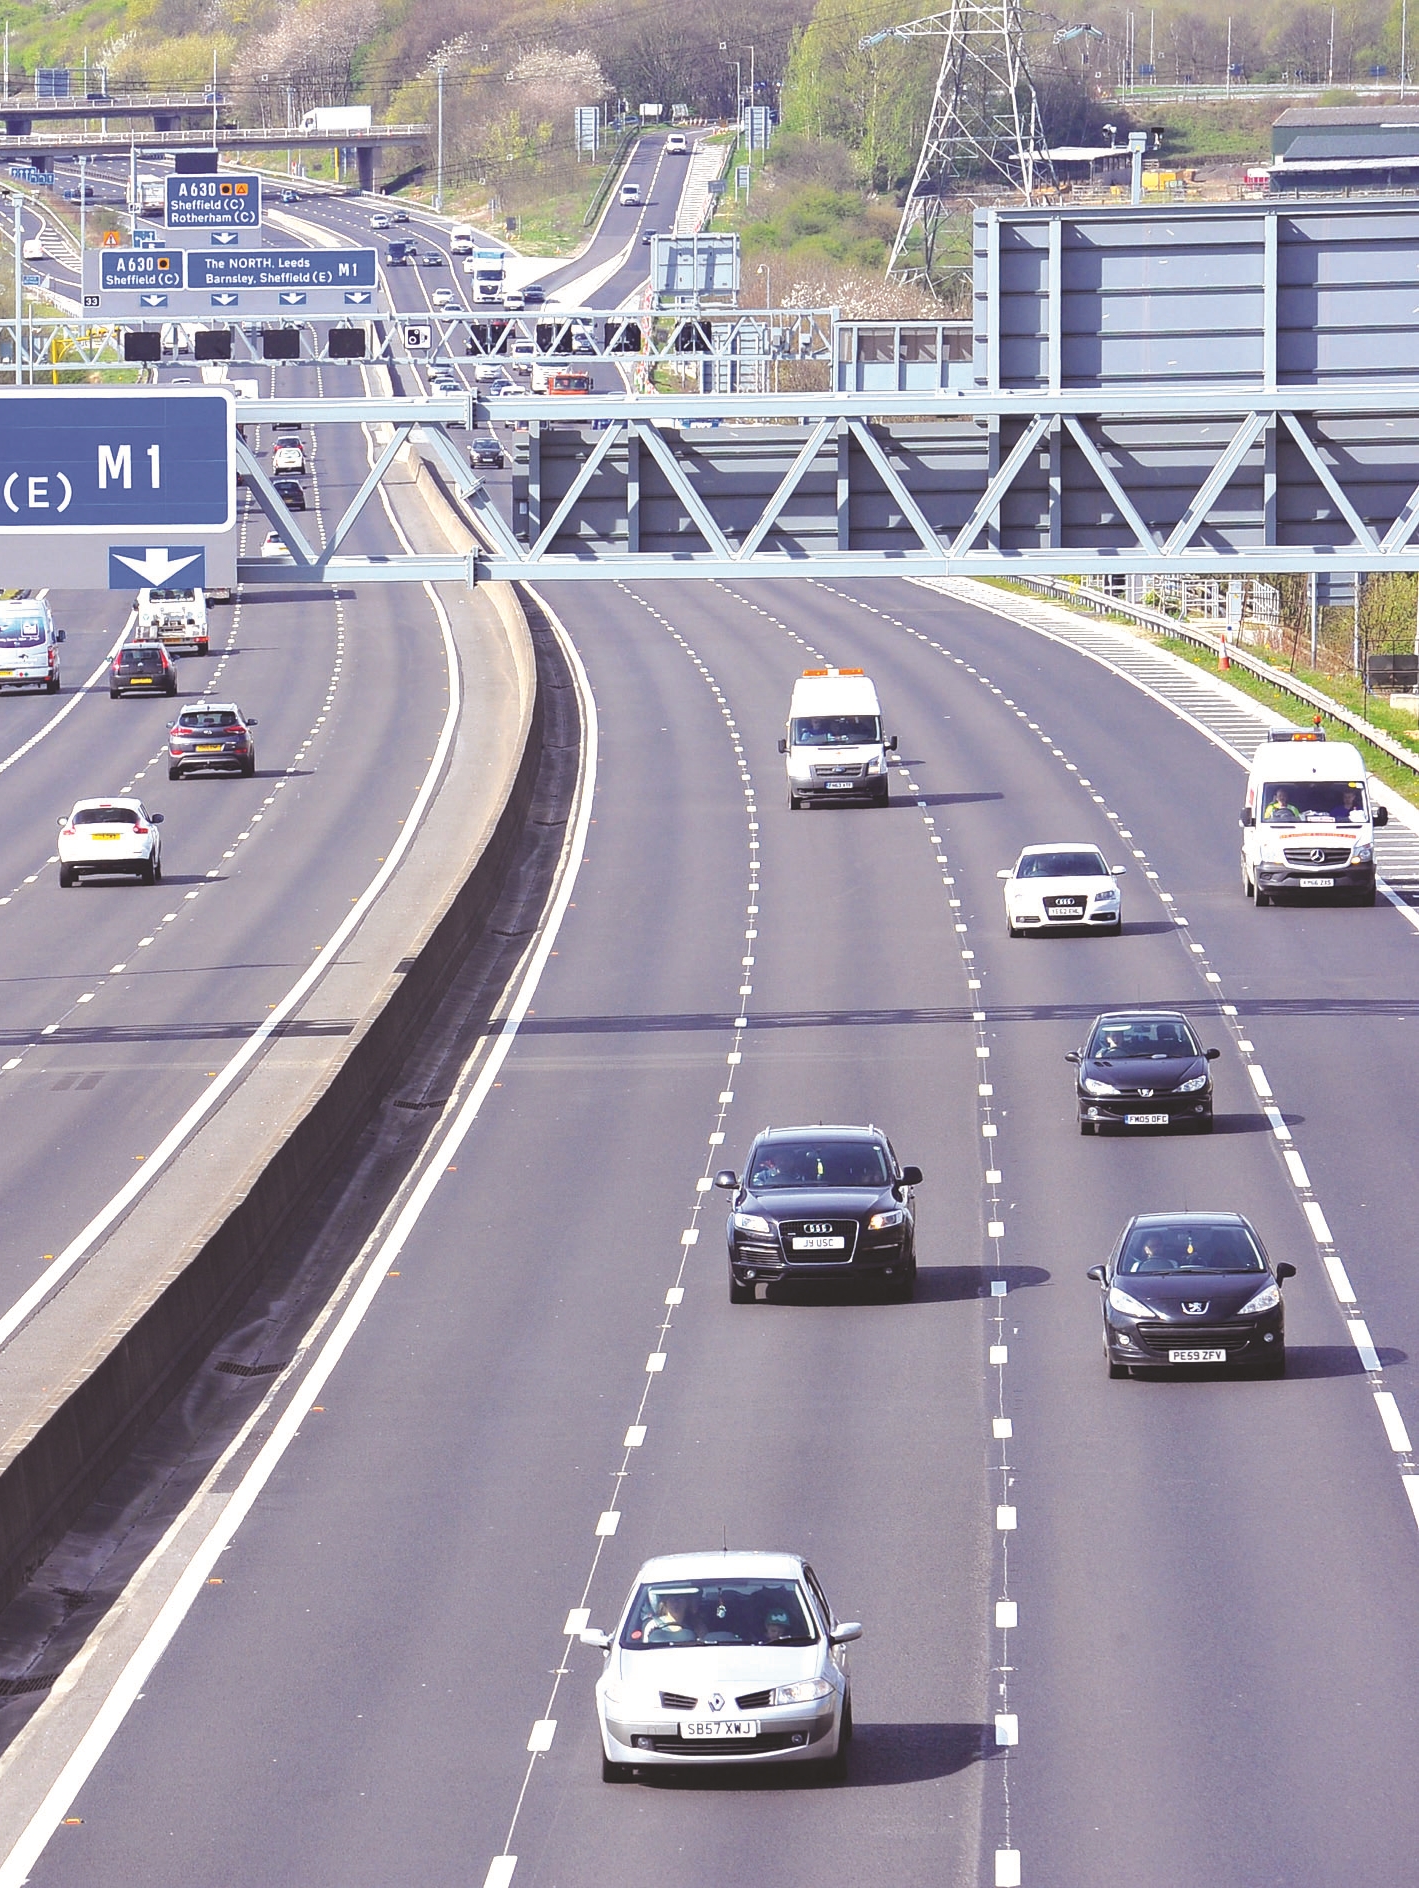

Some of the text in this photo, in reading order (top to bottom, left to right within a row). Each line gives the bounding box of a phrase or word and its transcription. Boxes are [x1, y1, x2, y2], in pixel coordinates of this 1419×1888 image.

[171, 198, 245, 211] Sheffield (C)
[171, 211, 256, 223] Rotherham (C)
[205, 257, 311, 269] The NORTH, Leeds
[105, 273, 180, 285] Sheffield (C)
[205, 271, 333, 285] Barnsley, Sheffield (E)
[85, 297, 98, 306] 33
[98, 444, 161, 489] M1
[3, 471, 72, 513] (E)
[1173, 1350, 1222, 1361] PE59 ZFV
[687, 1722, 751, 1735] SB57 XWJ
